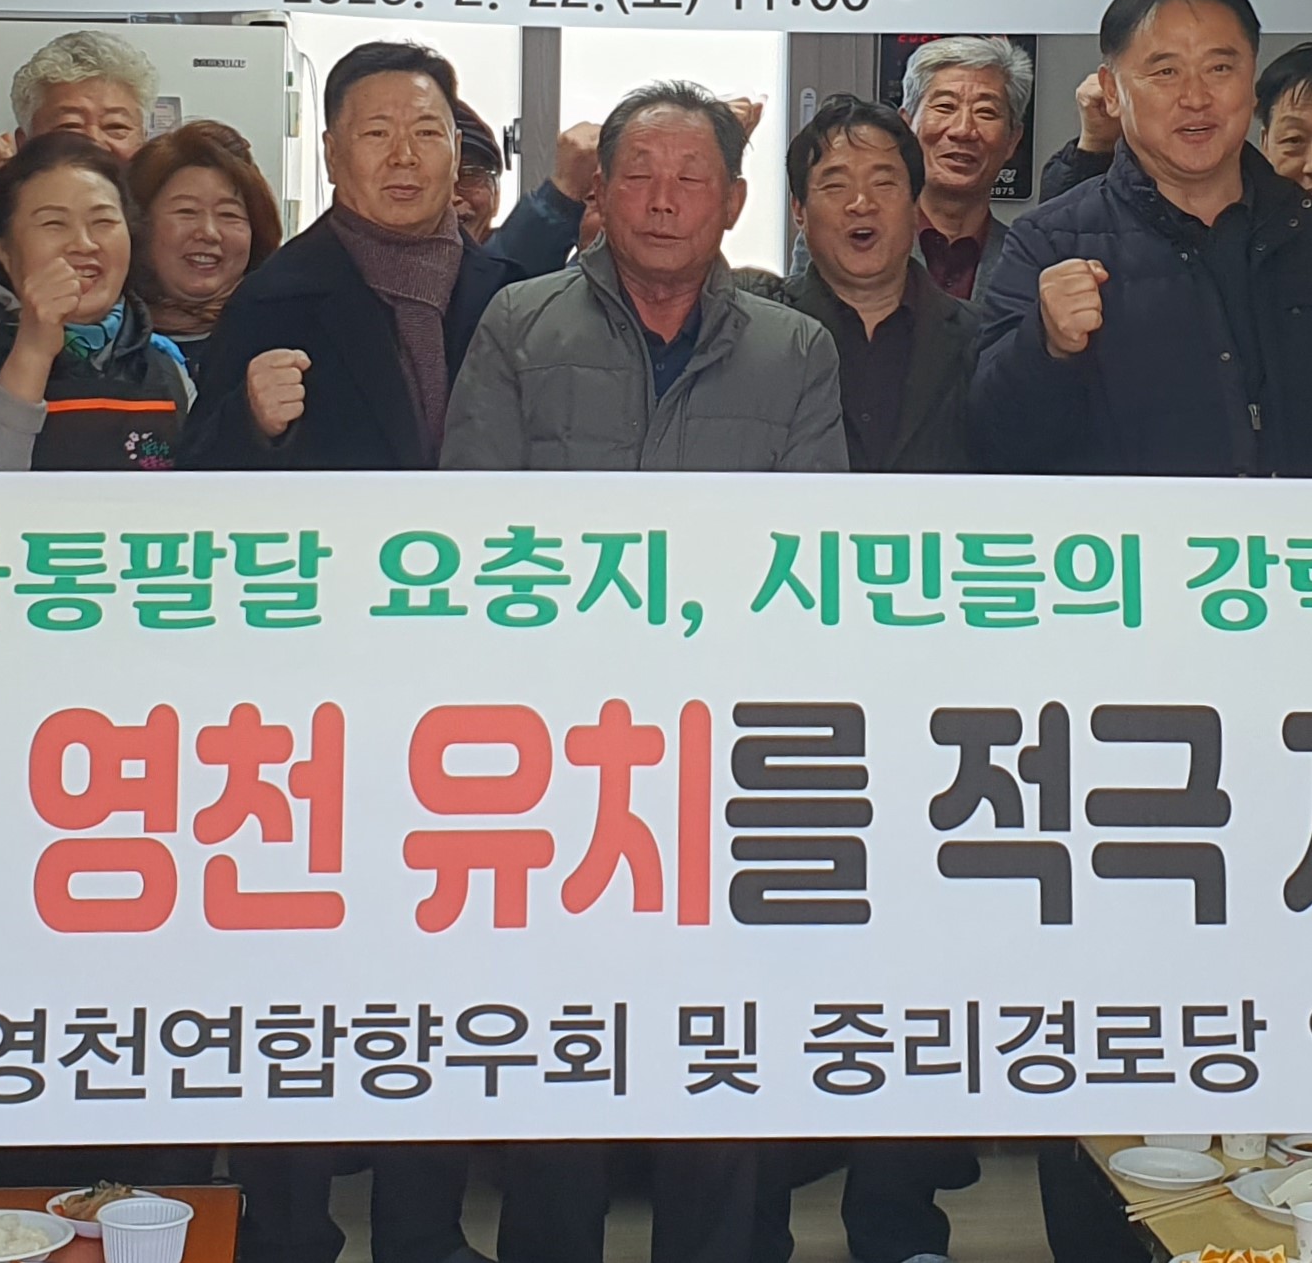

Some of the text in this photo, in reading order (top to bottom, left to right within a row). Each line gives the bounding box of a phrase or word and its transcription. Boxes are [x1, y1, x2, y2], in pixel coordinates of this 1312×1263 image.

[370, 527, 703, 638] 요충지,
[751, 532, 1142, 629] 시민들의
[29, 702, 345, 933] 영천
[403, 700, 873, 933] 유치를
[929, 701, 1232, 925] 적극
[677, 1001, 761, 1096] 및
[803, 999, 1267, 1096] 중리경로당
